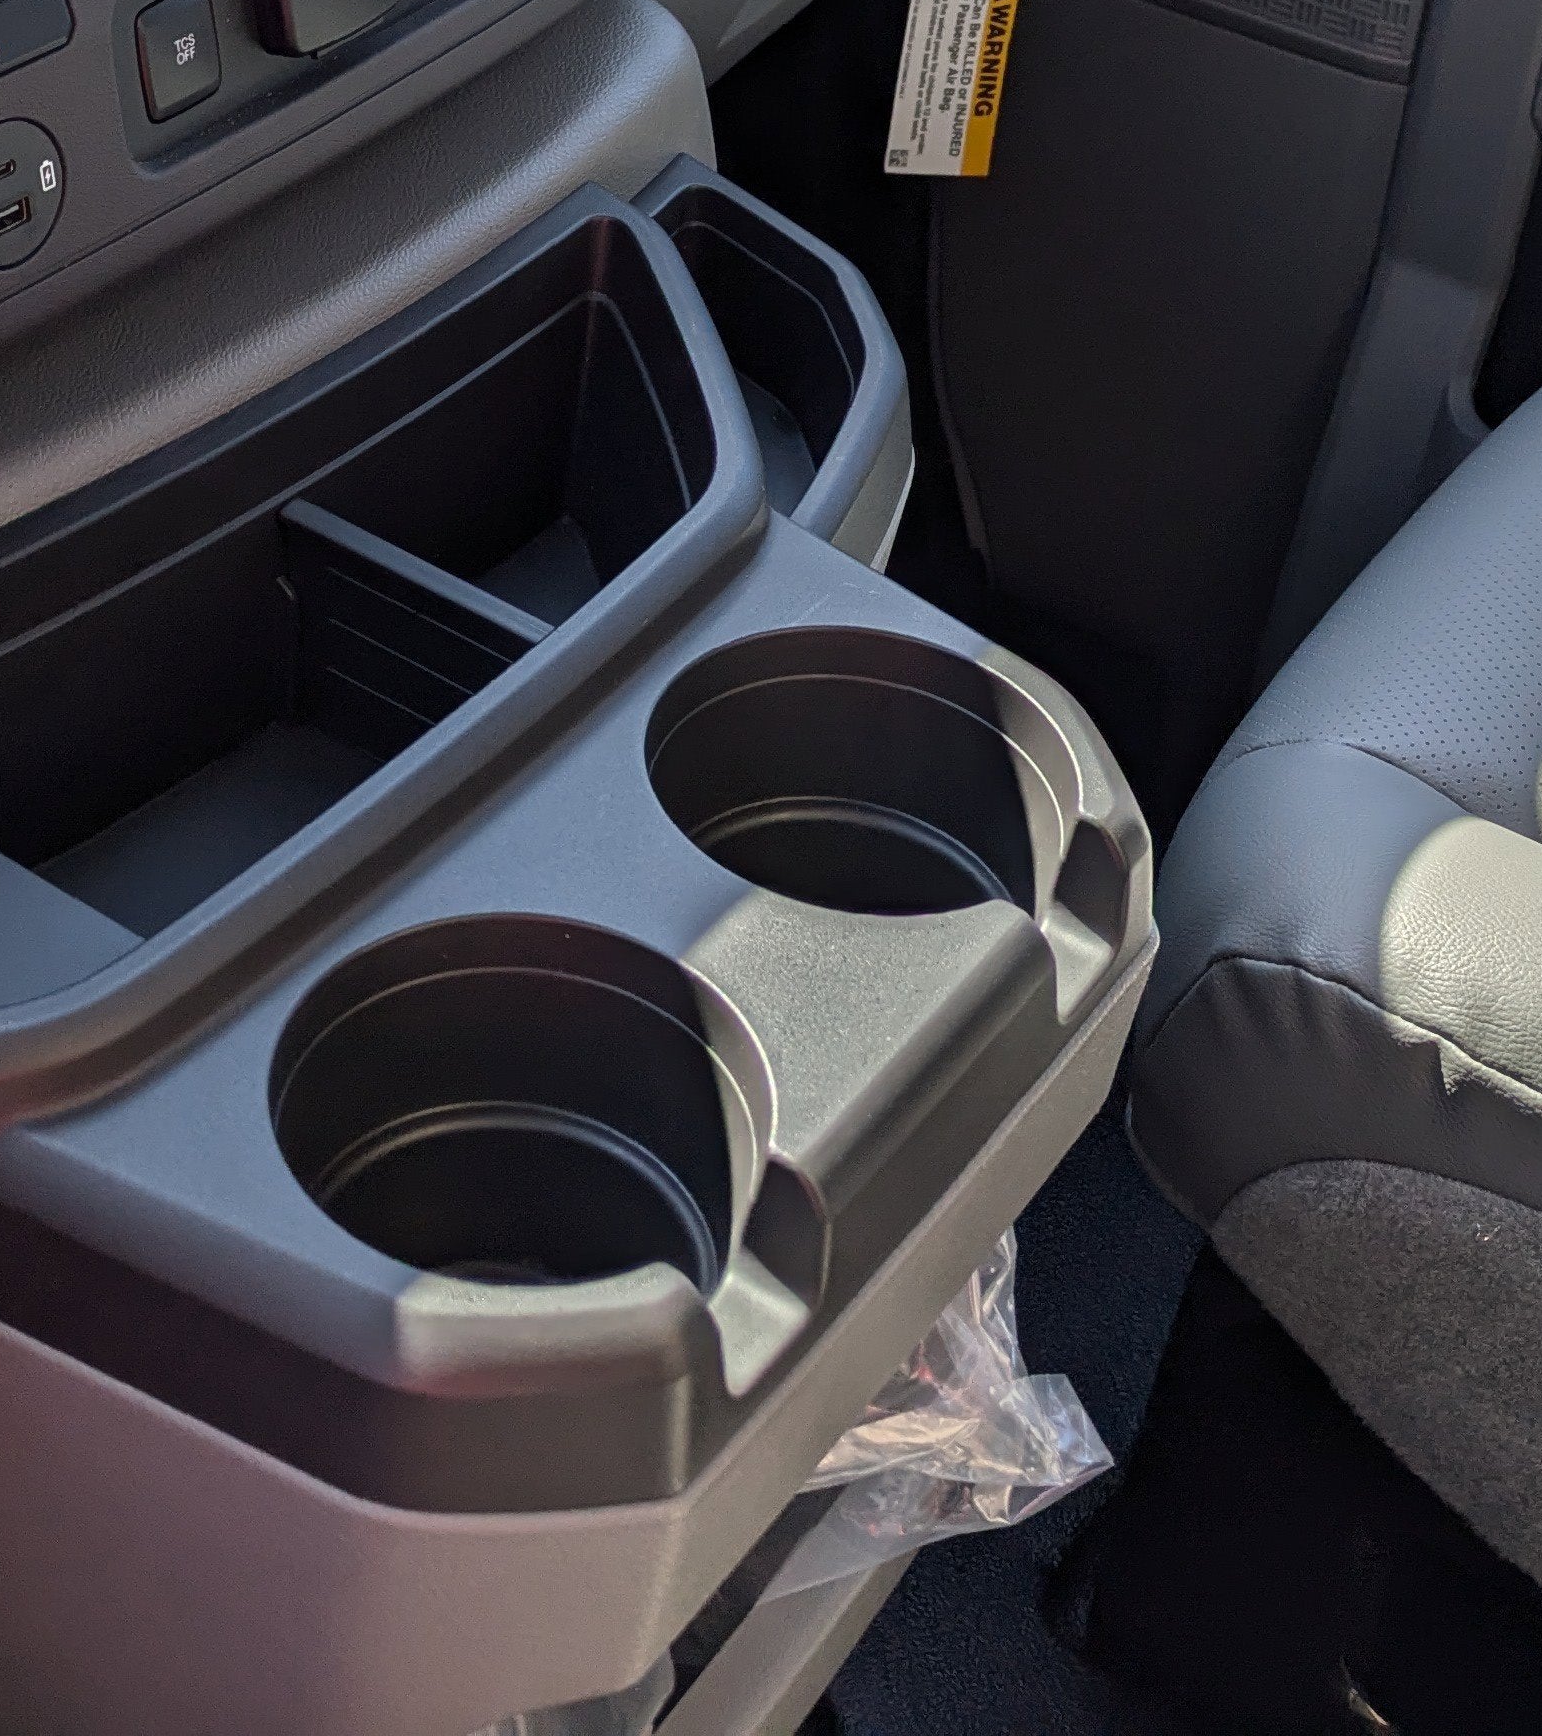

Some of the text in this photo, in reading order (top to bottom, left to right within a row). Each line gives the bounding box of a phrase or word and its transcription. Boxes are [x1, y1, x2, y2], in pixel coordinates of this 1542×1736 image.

[946, 3, 970, 65] Passenger
[968, 22, 981, 40] Be
[173, 32, 196, 53] TCS
[176, 45, 196, 66] OFF
[960, 41, 978, 86] KILLED
[973, 1, 1012, 119] WARNING
[947, 67, 959, 85] Air
[958, 87, 968, 101] or
[948, 103, 968, 157] INJURED
